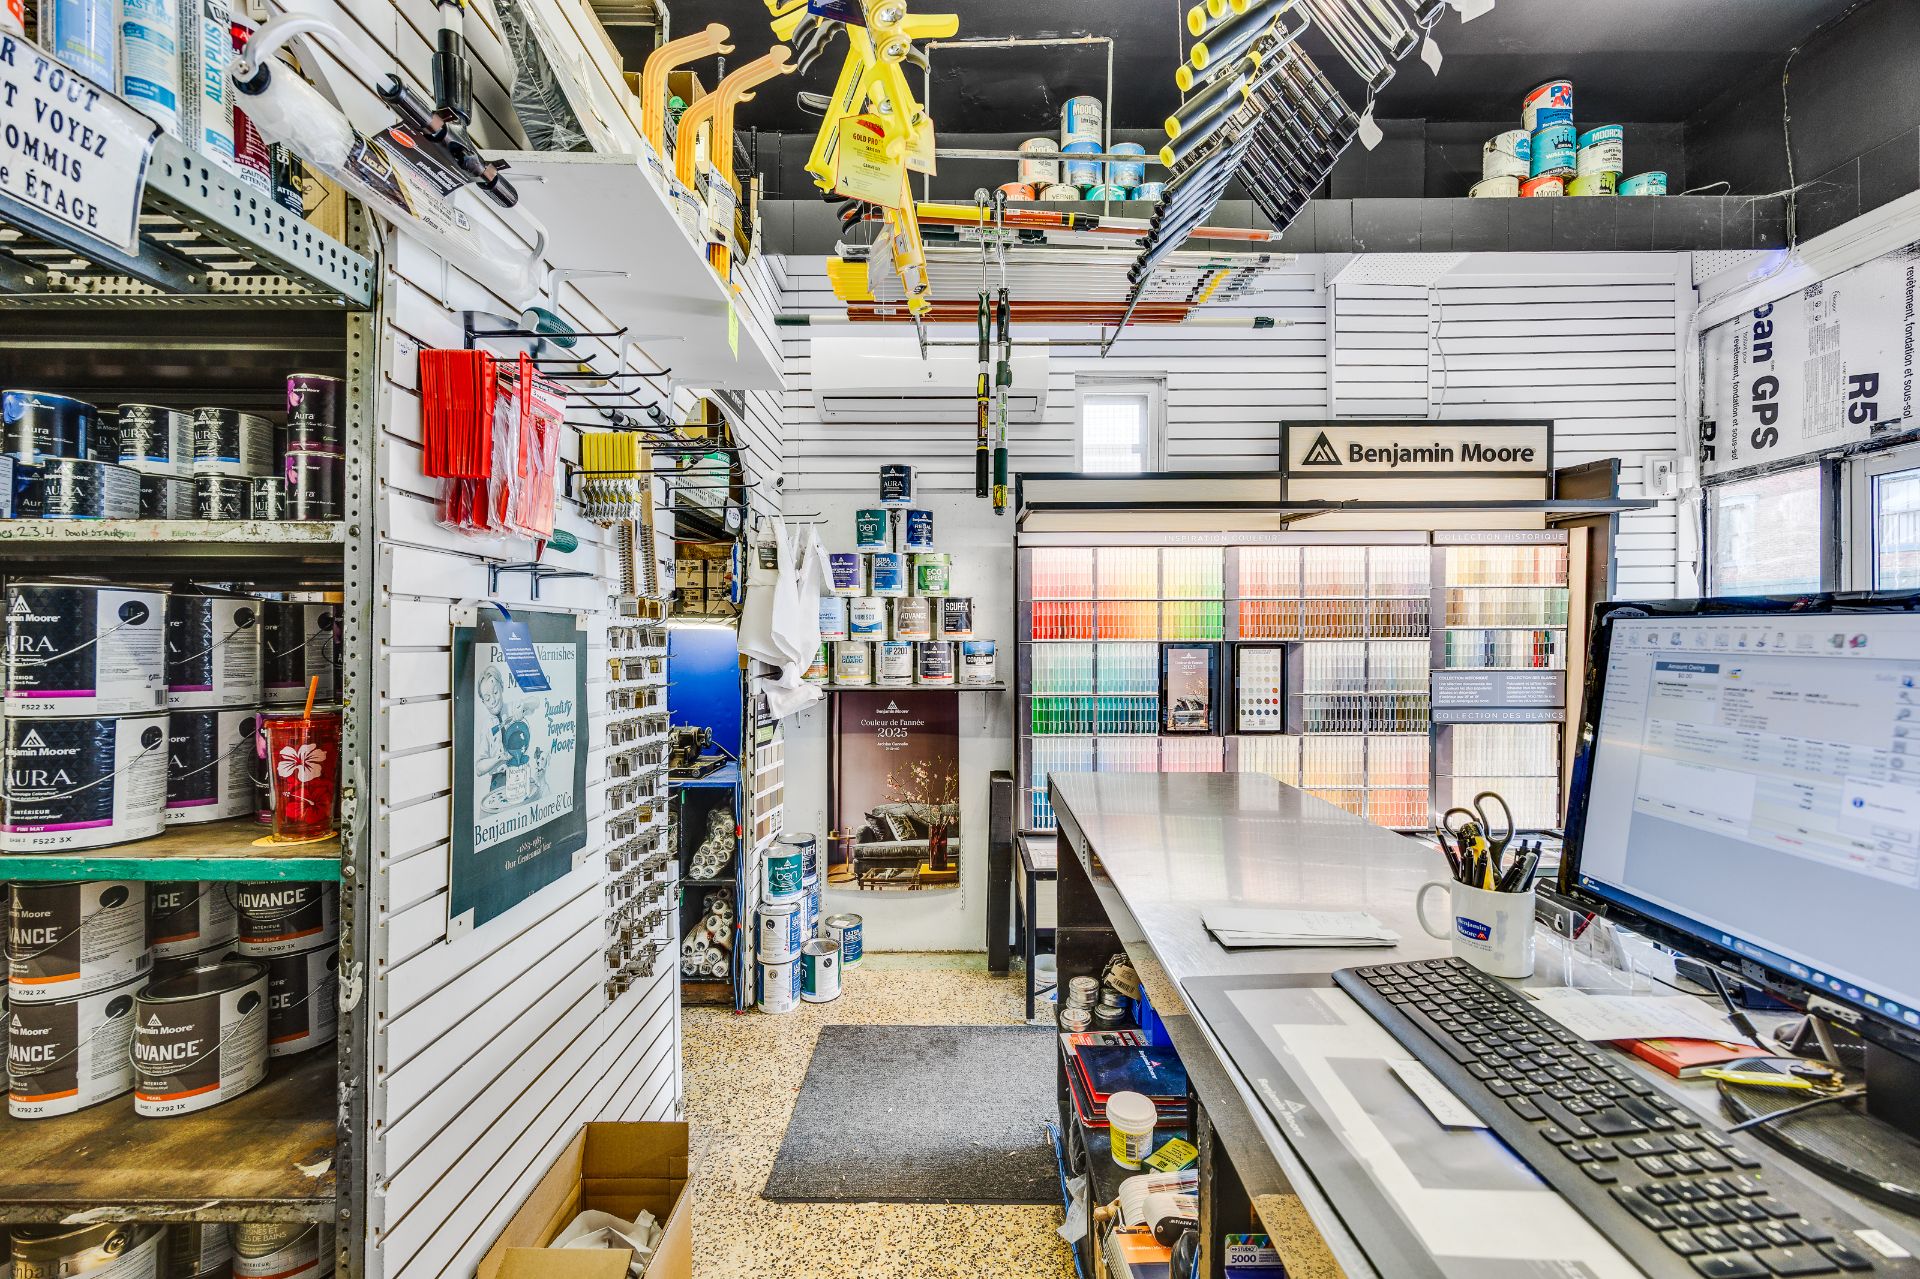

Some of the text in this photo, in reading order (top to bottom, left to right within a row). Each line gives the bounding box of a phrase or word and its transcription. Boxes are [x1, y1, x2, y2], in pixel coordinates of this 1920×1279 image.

[204, 21, 223, 105] ALEX PLUS
[34, 57, 100, 112] TOUT
[34, 97, 107, 158] VOYEZ
[852, 132, 867, 143] GOLD
[1, 123, 83, 183] OMMIS
[363, 154, 388, 176] NOUR
[26, 168, 98, 229] ÉTAGE
[1902, 266, 1916, 419] revêtement, fondation et sous-sol
[1732, 335, 1741, 381] revêtement,
[1732, 381, 1741, 416] fondation
[1848, 372, 1880, 425] R5
[294, 412, 315, 420] Aura
[1750, 374, 1780, 450] GPS
[1349, 443, 1535, 468] Benjamin Moore
[294, 489, 315, 497] Ara
[23, 499, 43, 507] Aur
[859, 523, 878, 532] ben
[1504, 533, 1565, 541] HISTORIQUE
[945, 602, 969, 611] SCUFF-X
[25, 613, 58, 623] Moore
[900, 612, 927, 620] ADVANCE
[537, 645, 575, 662] Varnishes
[1667, 663, 1706, 672] Amount Owing
[877, 727, 908, 738] 2025
[38, 747, 77, 756] Moore
[474, 812, 528, 847] Benjamin
[530, 802, 556, 827] Moore
[555, 795, 563, 812] &
[504, 859, 517, 871] Our
[776, 870, 799, 881] ben
[238, 887, 306, 909] ADVANCE
[21, 910, 52, 919] Moore
[1457, 917, 1487, 932] Benjamin
[1457, 925, 1478, 938] Moore
[9, 926, 58, 945] VANCE
[20, 1027, 49, 1036] Moore
[136, 1024, 193, 1035] njamin Moore
[9, 1044, 56, 1062] VANCE
[135, 1039, 200, 1062] DVANCE
[1256, 1078, 1305, 1138] Benjamin Moore
[252, 1232, 287, 1242] DE BAINS
[1231, 1254, 1257, 1264] 5000
